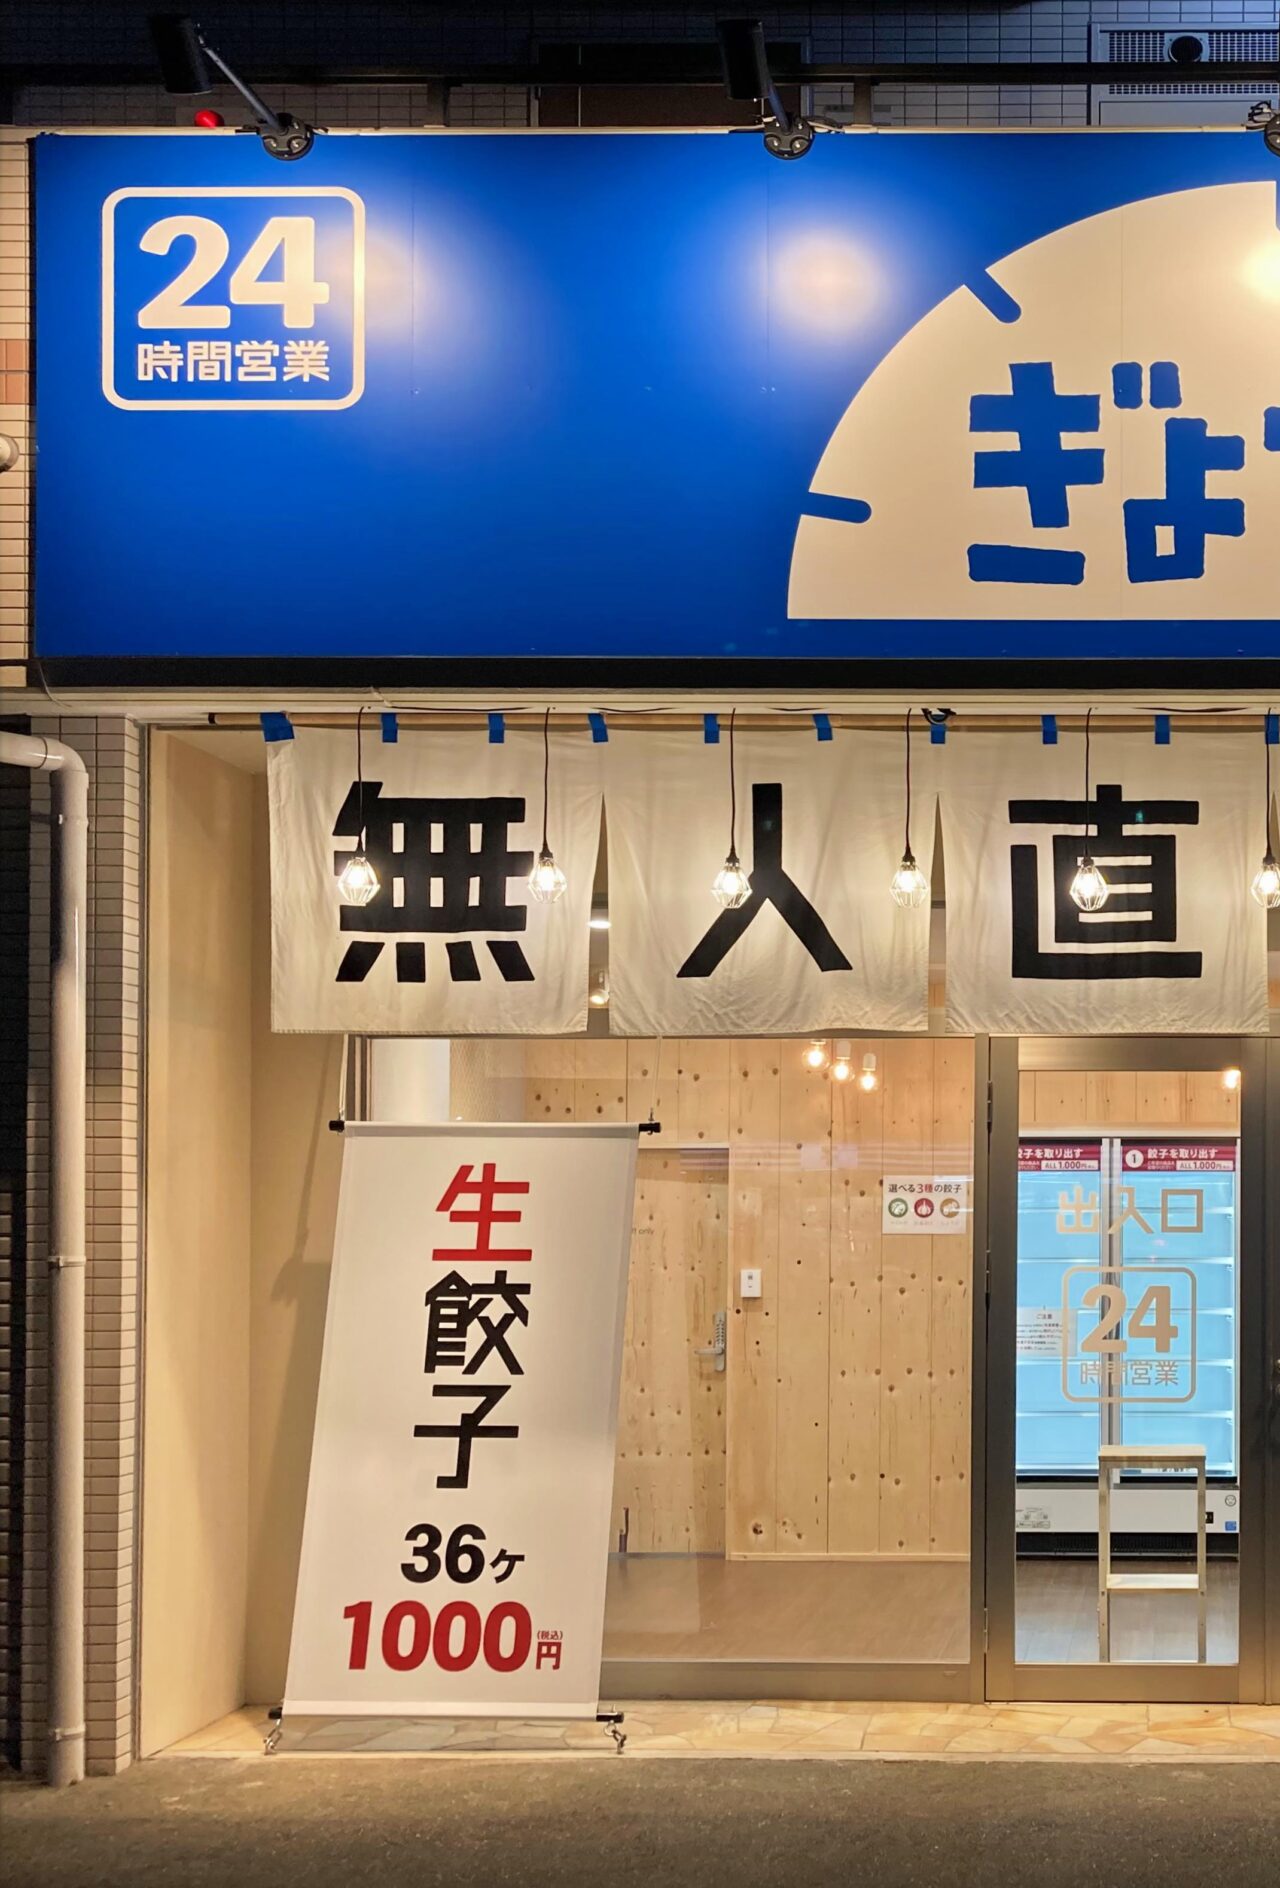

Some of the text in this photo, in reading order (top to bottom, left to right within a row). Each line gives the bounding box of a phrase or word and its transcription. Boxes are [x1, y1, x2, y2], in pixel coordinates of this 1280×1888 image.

[138, 215, 330, 329] 24
[137, 340, 330, 382] 時間営業
[1147, 1148, 1218, 1159] 餃子を取り出す
[1056, 1185, 1204, 1234] 出入口
[414, 1163, 532, 1489] 生餃子
[1081, 1284, 1179, 1353] 24
[1080, 1361, 1180, 1386] 時間営業
